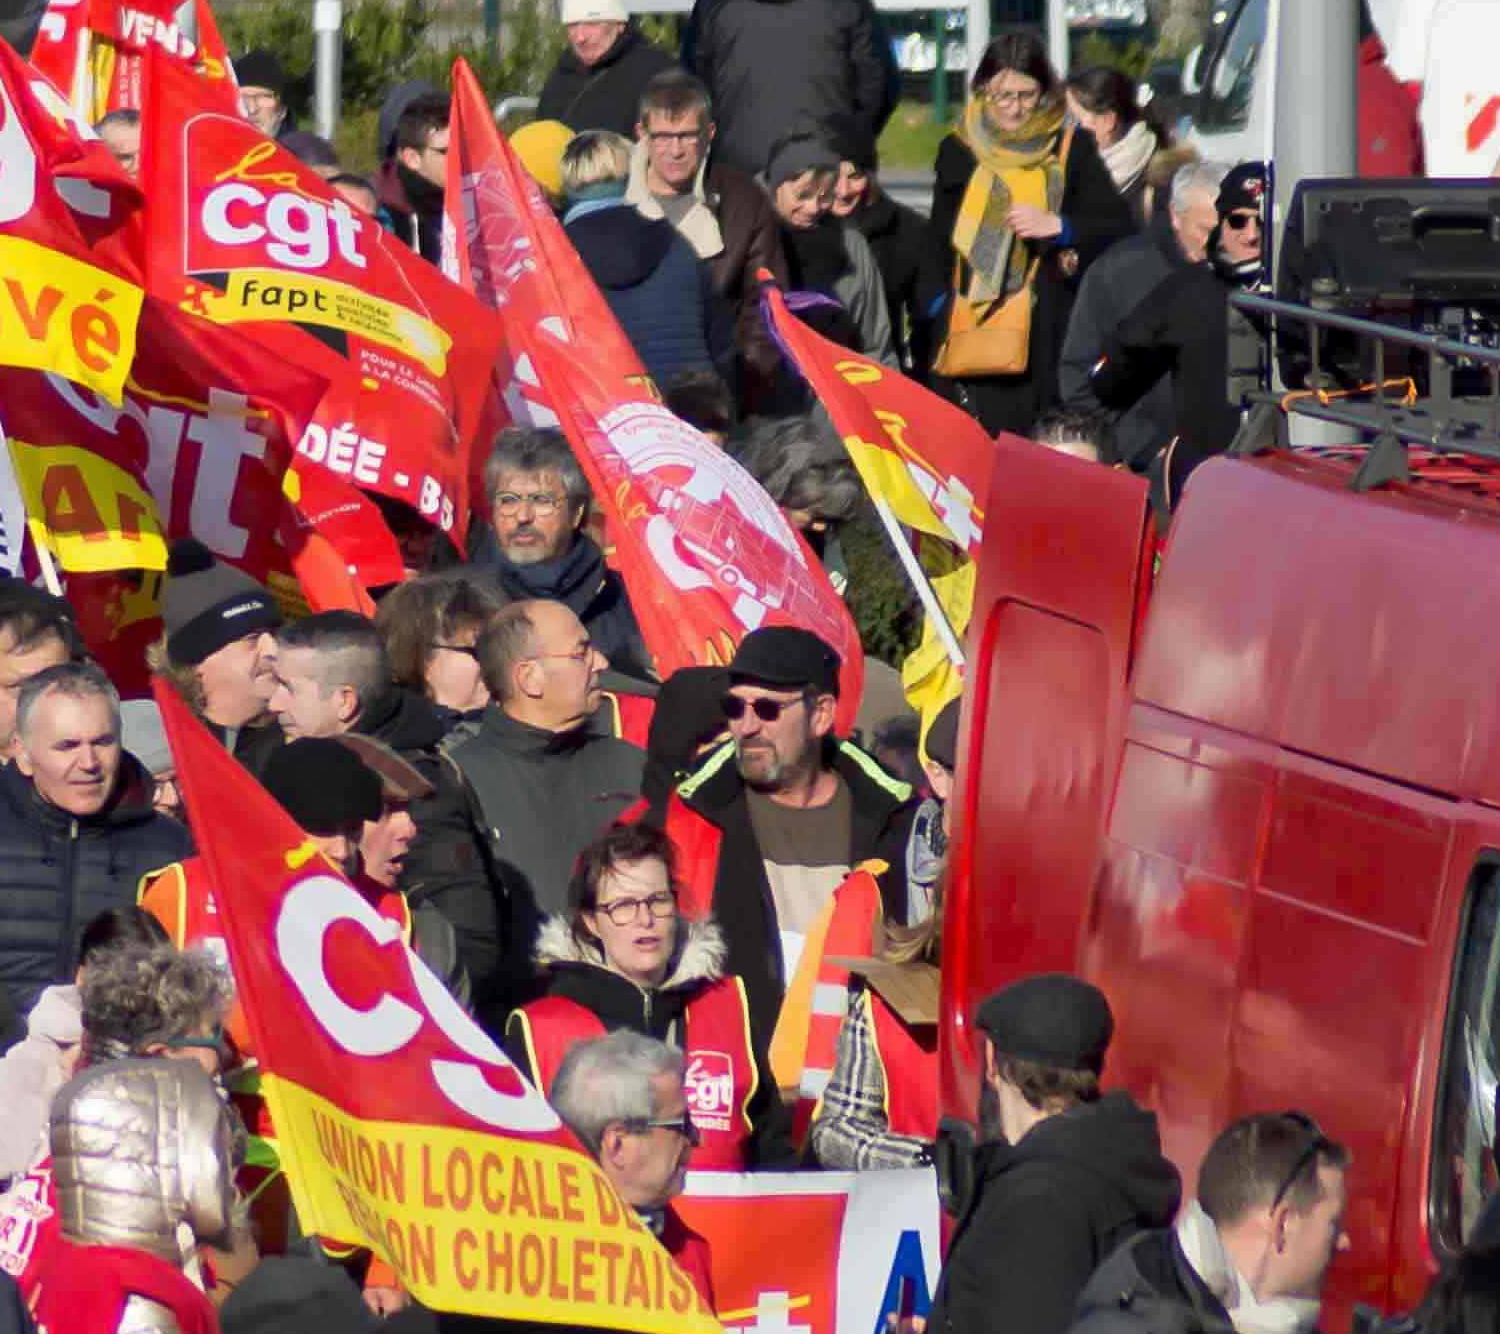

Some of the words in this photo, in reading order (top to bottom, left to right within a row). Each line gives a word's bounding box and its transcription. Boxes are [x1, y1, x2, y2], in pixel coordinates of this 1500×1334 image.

[200, 182, 367, 269] cgt
[241, 279, 328, 313] fapt
[301, 423, 387, 486] DÉE
[312, 1106, 406, 1206] UNION
[423, 1144, 584, 1222] LOCALE
[453, 1228, 694, 1314] CHOLETAIS
